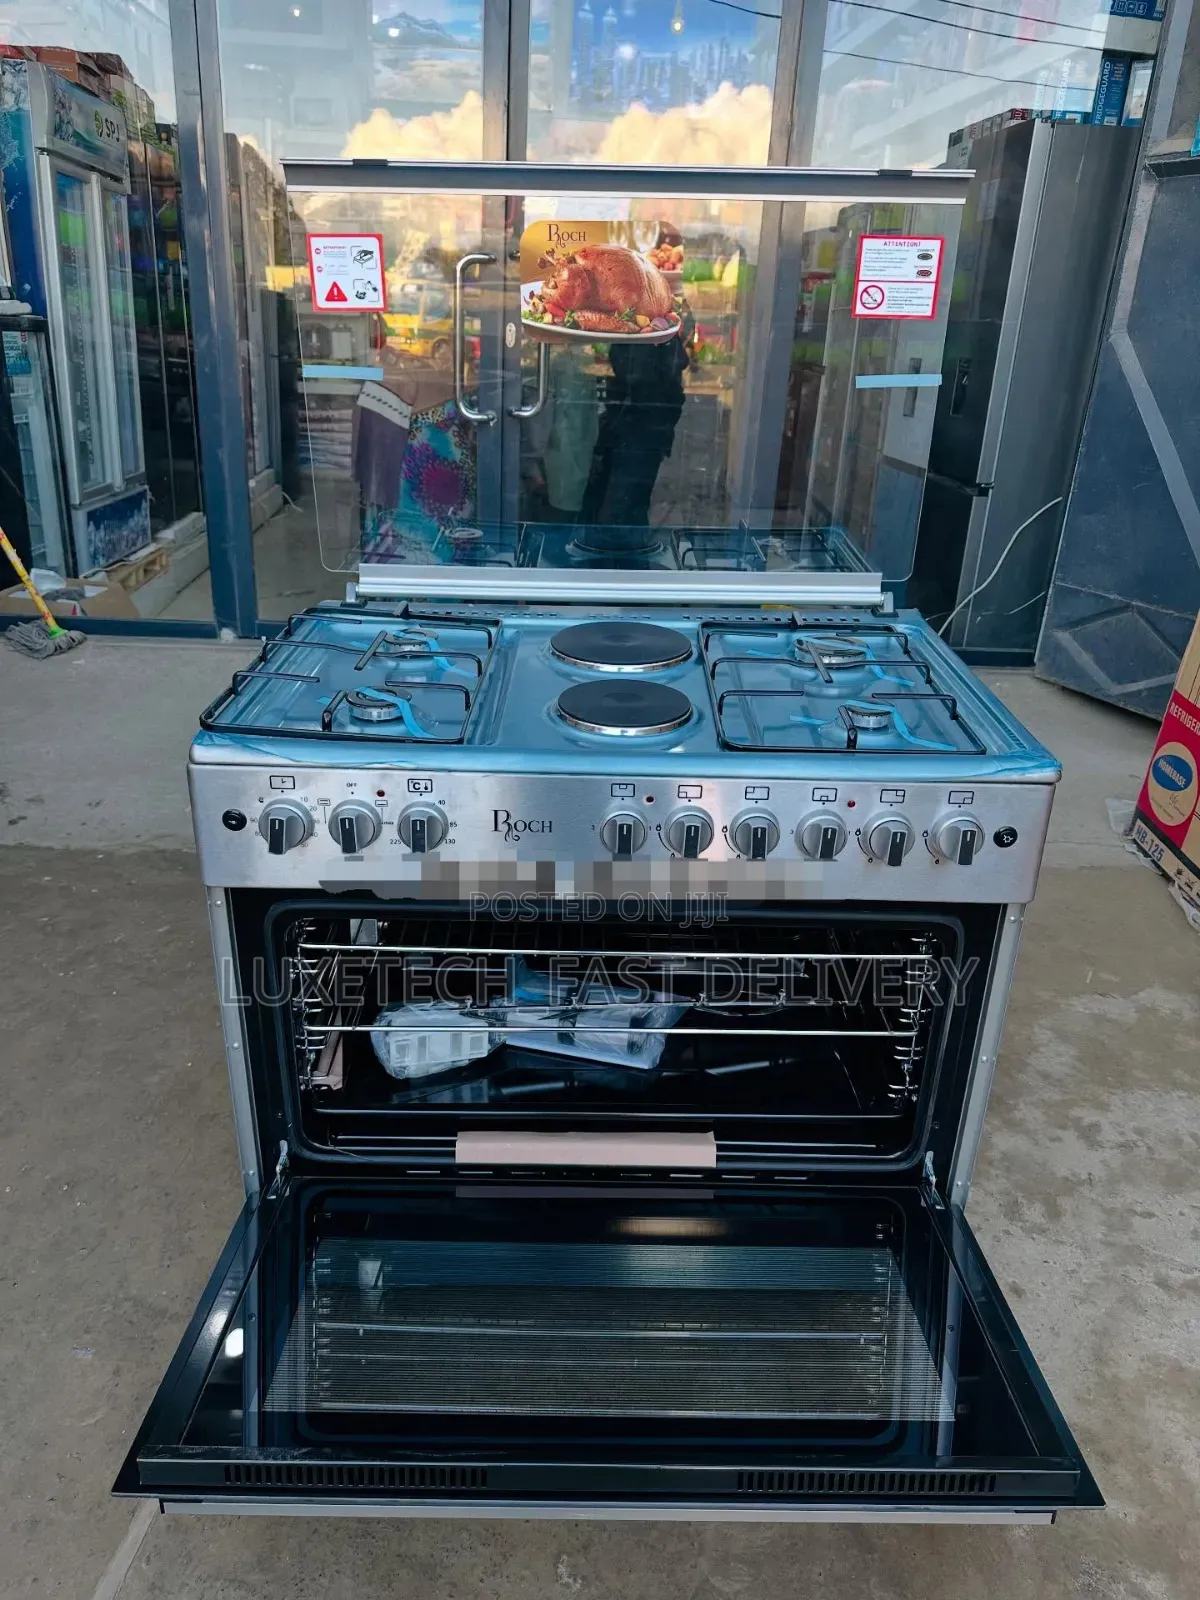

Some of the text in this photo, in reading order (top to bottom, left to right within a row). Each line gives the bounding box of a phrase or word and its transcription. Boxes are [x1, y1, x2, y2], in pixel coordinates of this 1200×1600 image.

[1094, 60, 1111, 124] FRIDGEGUARD
[1158, 759, 1187, 788] HOMEBASE
[1136, 825, 1165, 862] HB-125
